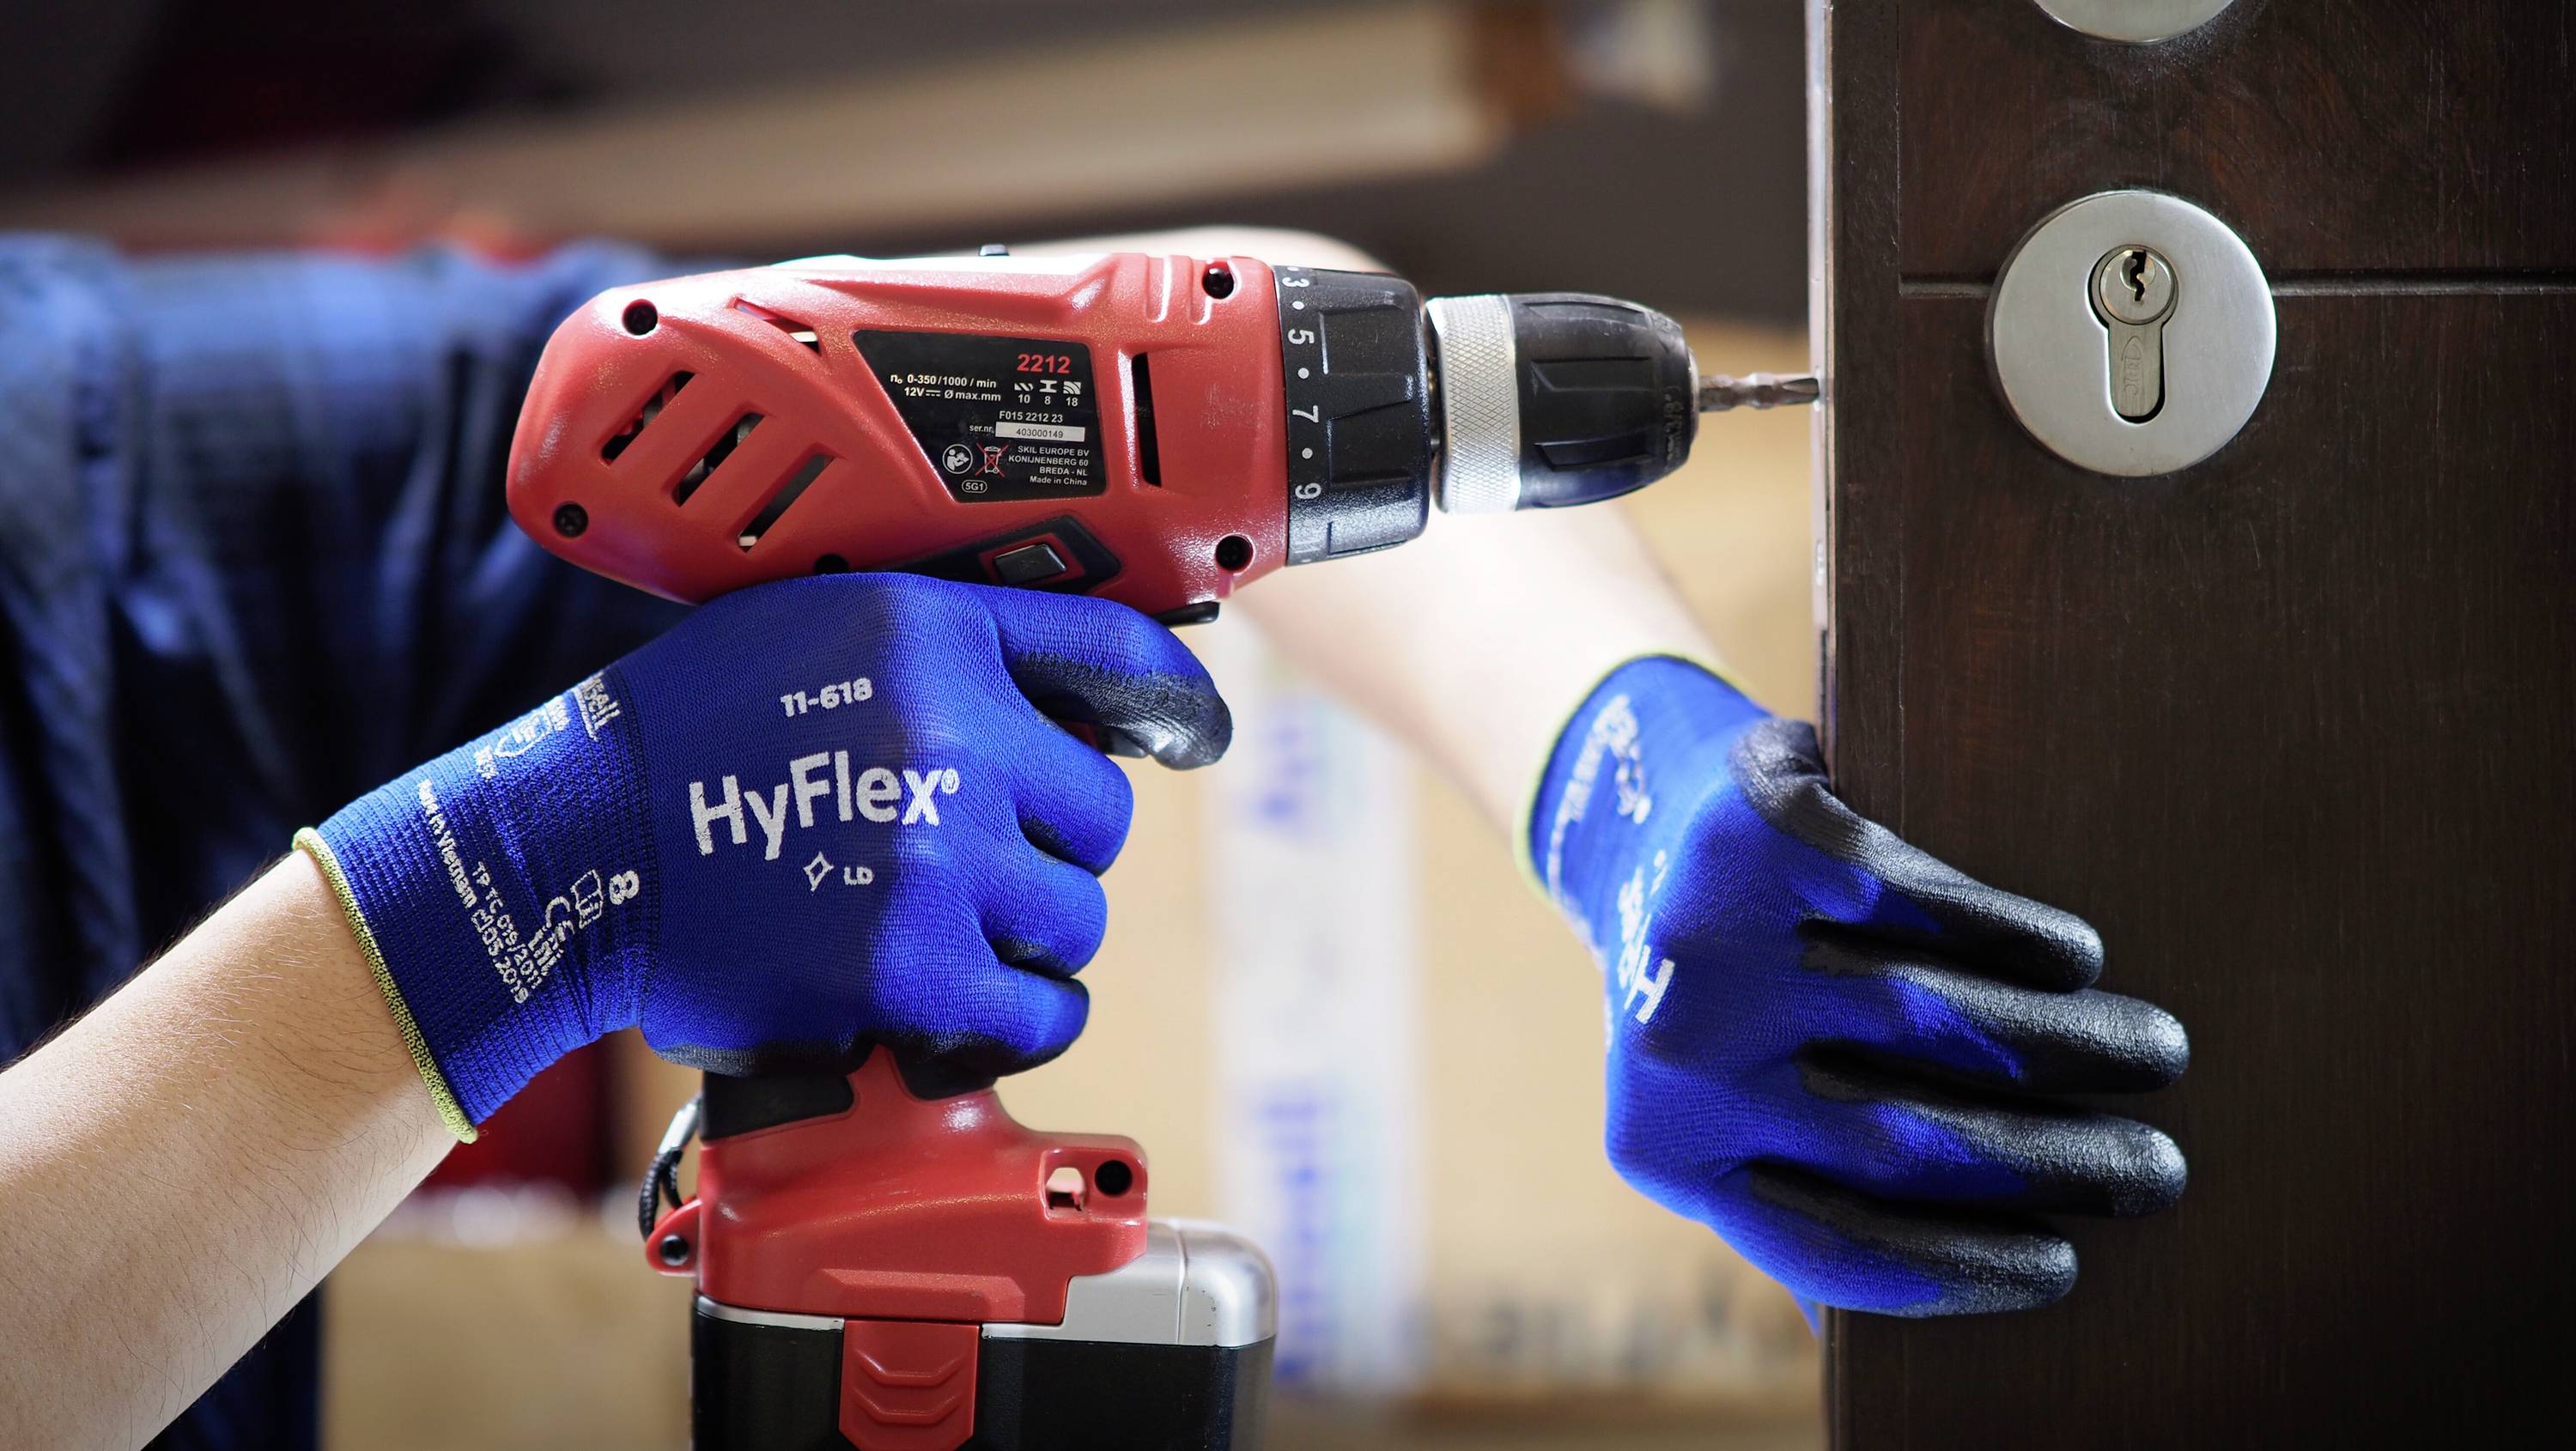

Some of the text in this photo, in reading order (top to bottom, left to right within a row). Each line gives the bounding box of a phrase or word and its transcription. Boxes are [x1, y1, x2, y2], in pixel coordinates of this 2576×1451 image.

[1282, 275, 1310, 288] 3
[1287, 329, 1315, 346] 5
[1017, 354, 1071, 373] 2212
[975, 379, 997, 389] min
[955, 392, 1001, 402] max.mm
[1018, 393, 1078, 407] 10 8 18
[999, 410, 1063, 423] F015 2212 23
[1291, 404, 1320, 425] 7
[1016, 428, 1064, 439] 403000149
[1018, 445, 1090, 457] SKIL EUROPE BV
[1008, 454, 1089, 467] KONIJNENBERG 60
[1039, 466, 1070, 476] BREDA
[1076, 468, 1088, 477] NL
[964, 482, 984, 491] 5G1
[1030, 475, 1087, 486] Made in China
[1294, 482, 1322, 501] 9
[780, 677, 873, 718] 11-618
[435, 833, 477, 909] Vietnam
[843, 865, 874, 886] LD
[472, 861, 491, 889] TP
[485, 886, 505, 915] TC
[609, 869, 641, 906] 8
